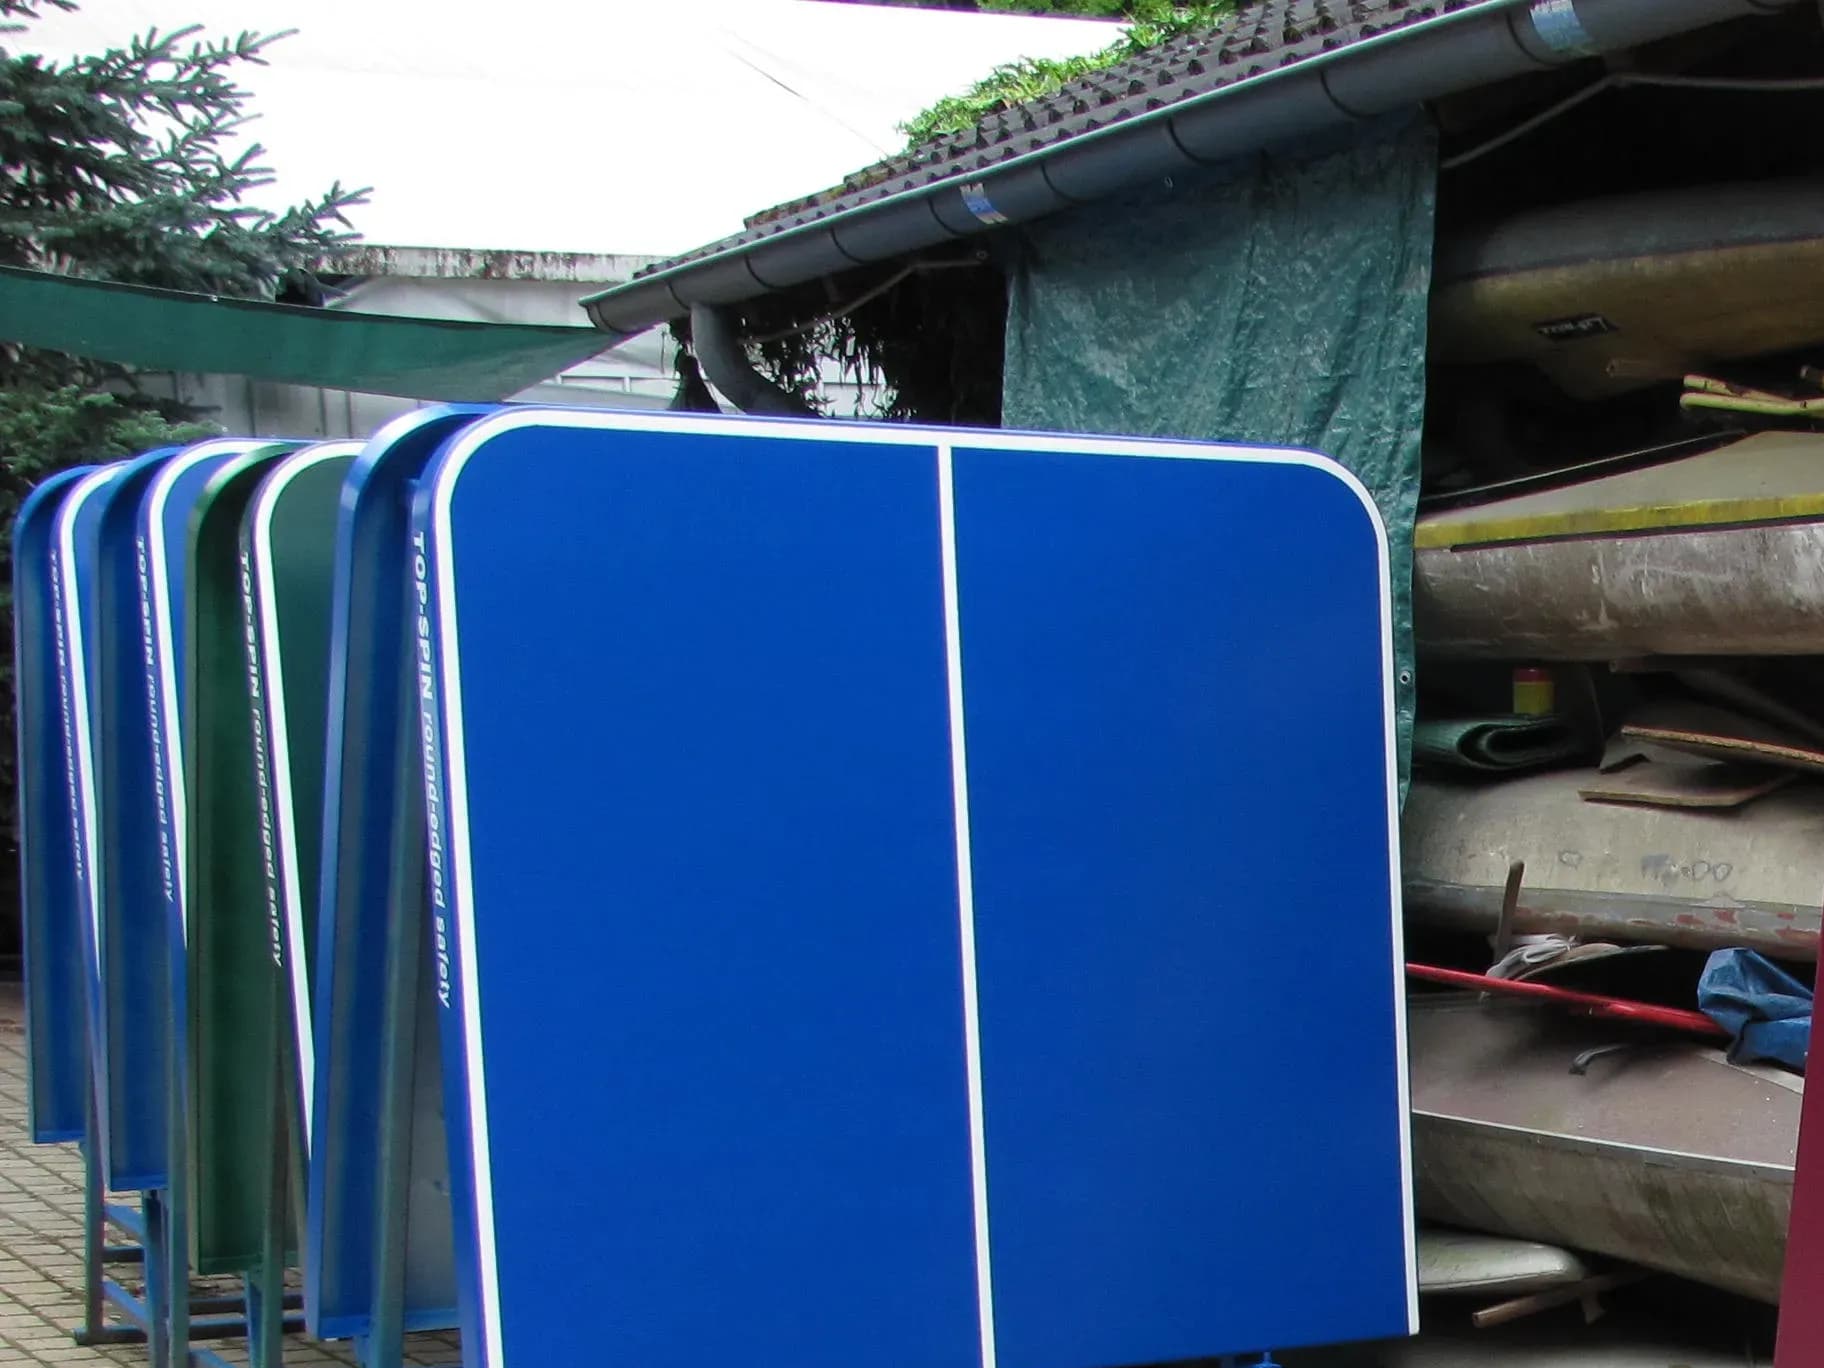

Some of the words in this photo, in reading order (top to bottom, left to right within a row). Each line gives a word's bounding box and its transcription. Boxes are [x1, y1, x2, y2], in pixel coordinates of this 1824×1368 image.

[413, 531, 433, 701] TOP-SPIN
[136, 536, 154, 666] TOP-SPIN
[160, 832, 175, 903] safety
[240, 552, 260, 699] TOP-SPIN
[252, 708, 276, 879] round-edged
[267, 886, 283, 967] safety
[422, 711, 446, 908] round-edged
[435, 916, 452, 1009] safety
